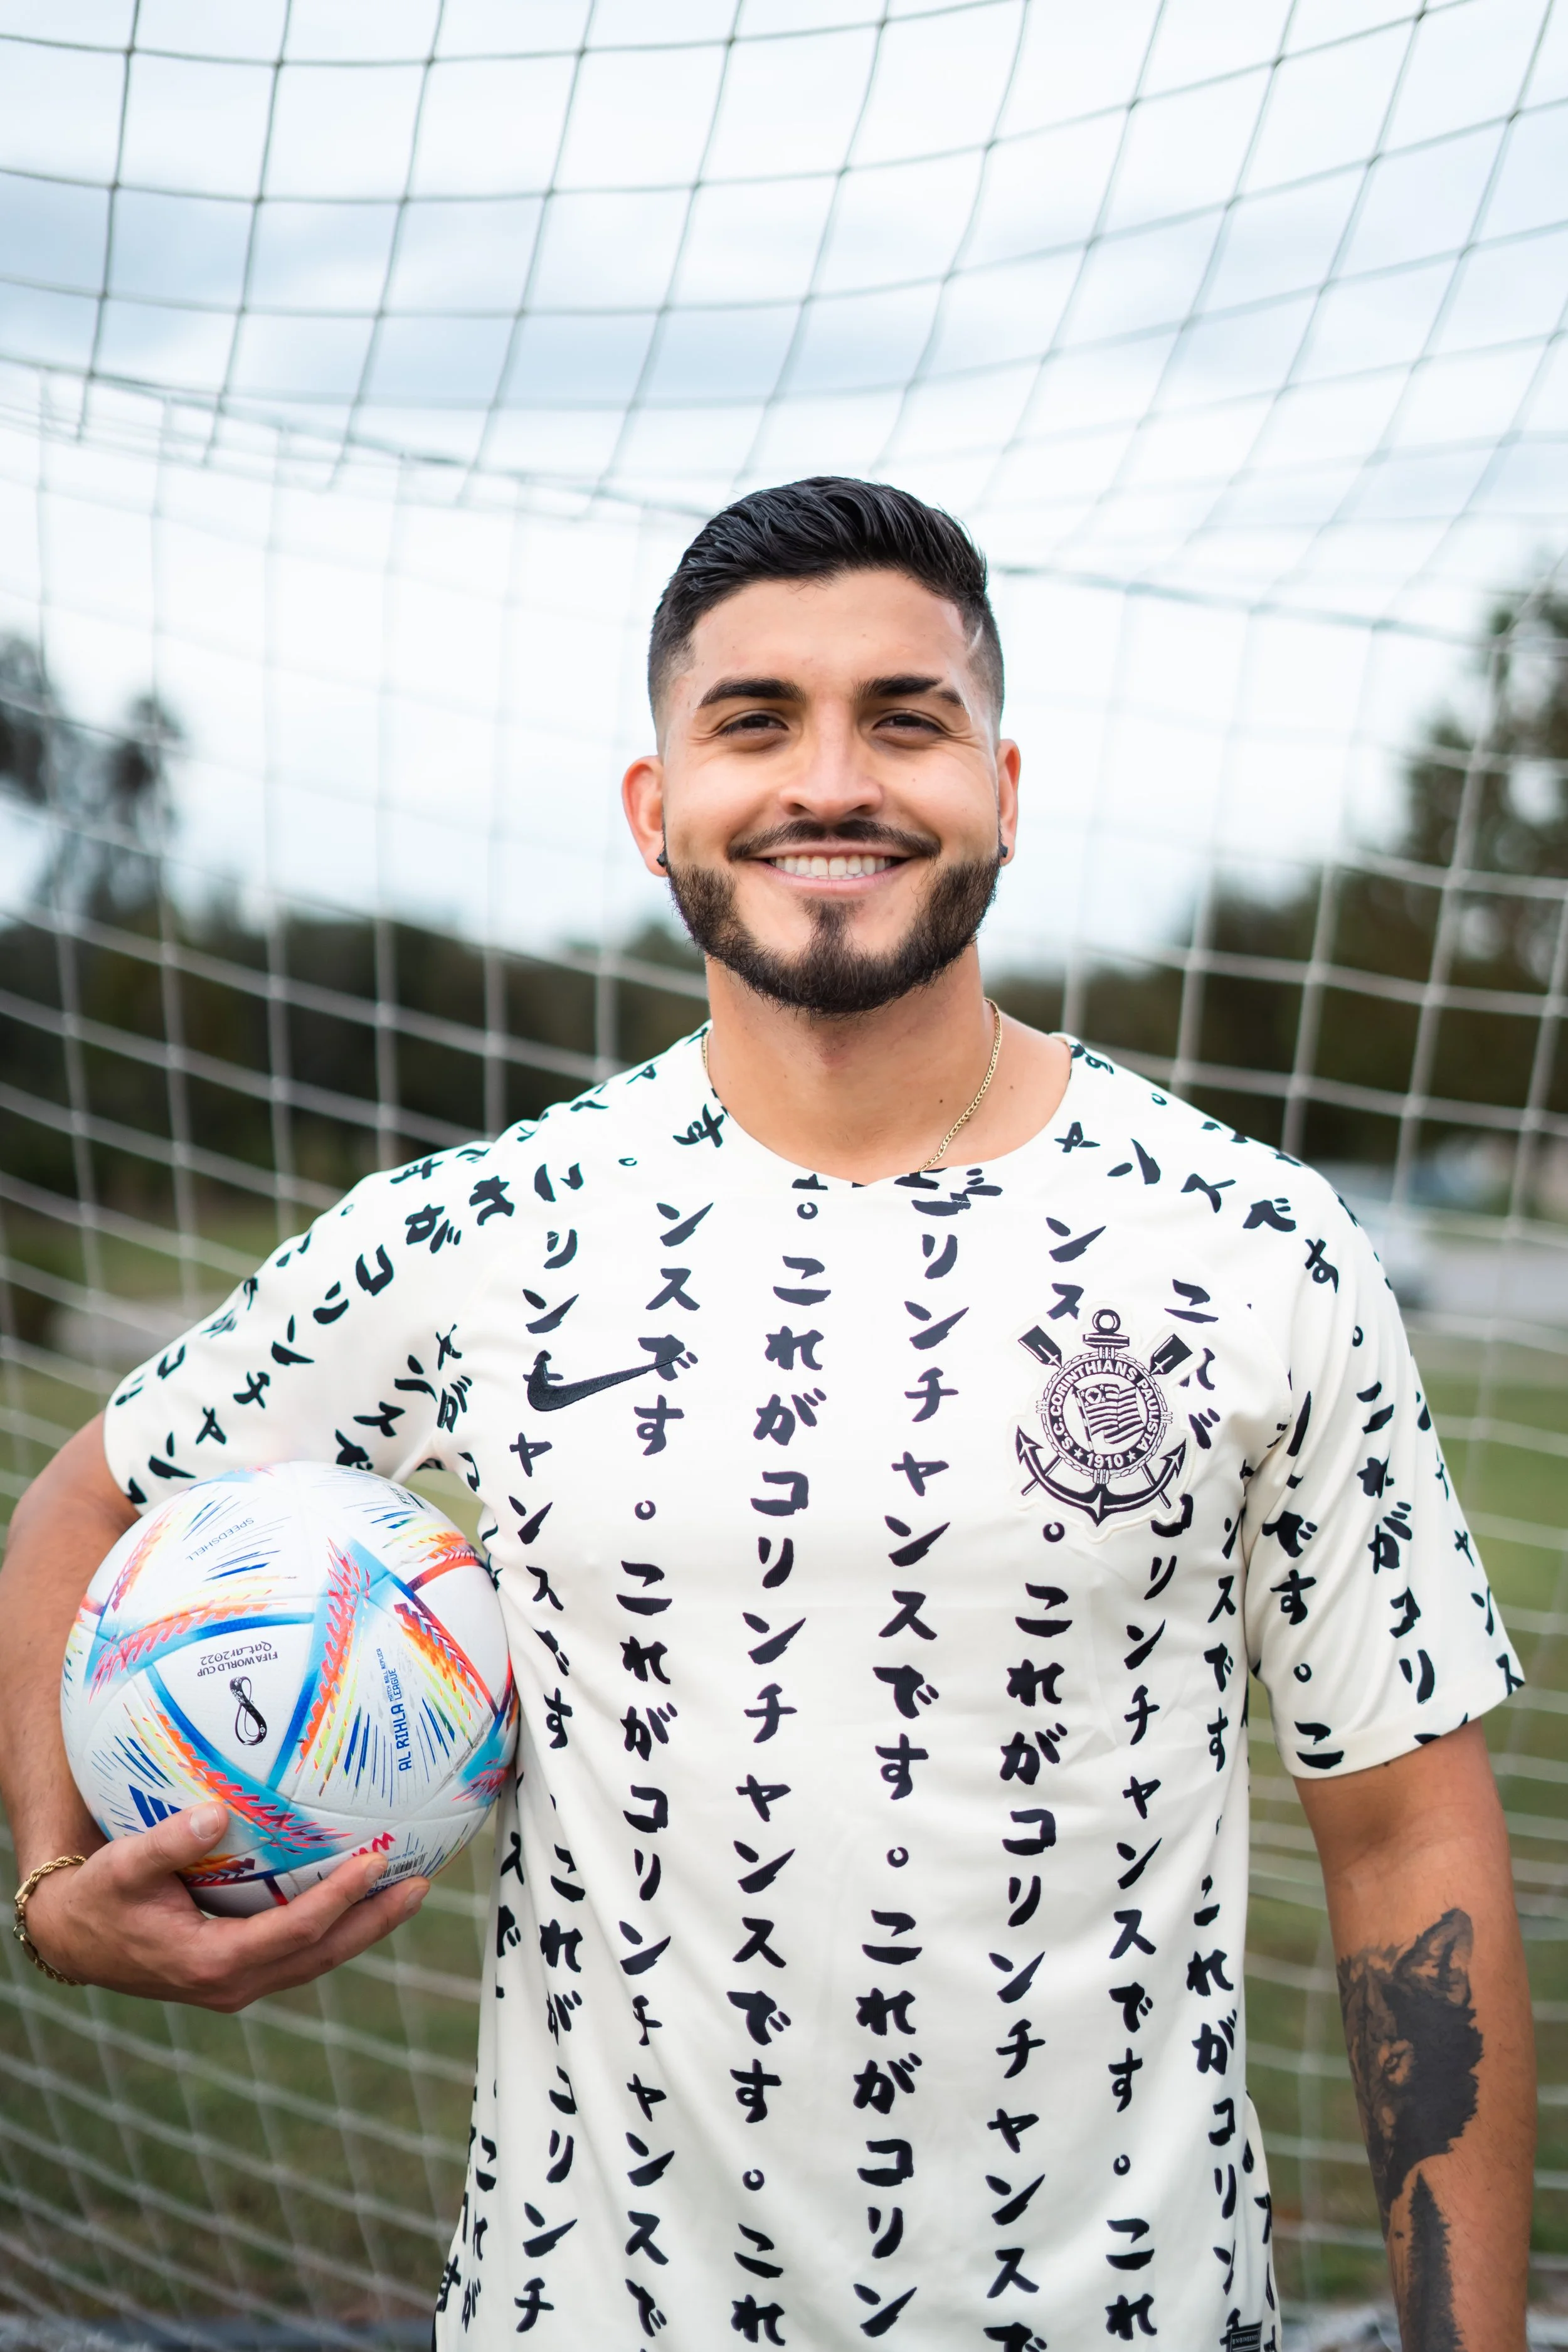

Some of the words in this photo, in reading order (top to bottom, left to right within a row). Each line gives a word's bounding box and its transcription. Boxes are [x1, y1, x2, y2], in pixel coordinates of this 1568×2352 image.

[1051, 1360, 1138, 1417] CORINTHIANS
[1136, 1380, 1160, 1452] PAULISTA
[1086, 1453, 1123, 1469] 1910
[185, 1517, 254, 1561] SPEEDSHELL
[218, 1655, 255, 1671] WORLD
[254, 1650, 278, 1663] FIFA
[376, 1648, 386, 1670] REPLICA
[196, 1663, 216, 1677] CUP
[386, 1685, 395, 1702] MATCH
[388, 1668, 402, 1701] LEAGUE
[390, 1703, 410, 1750] RIHLA
[398, 1751, 412, 1772] AL
